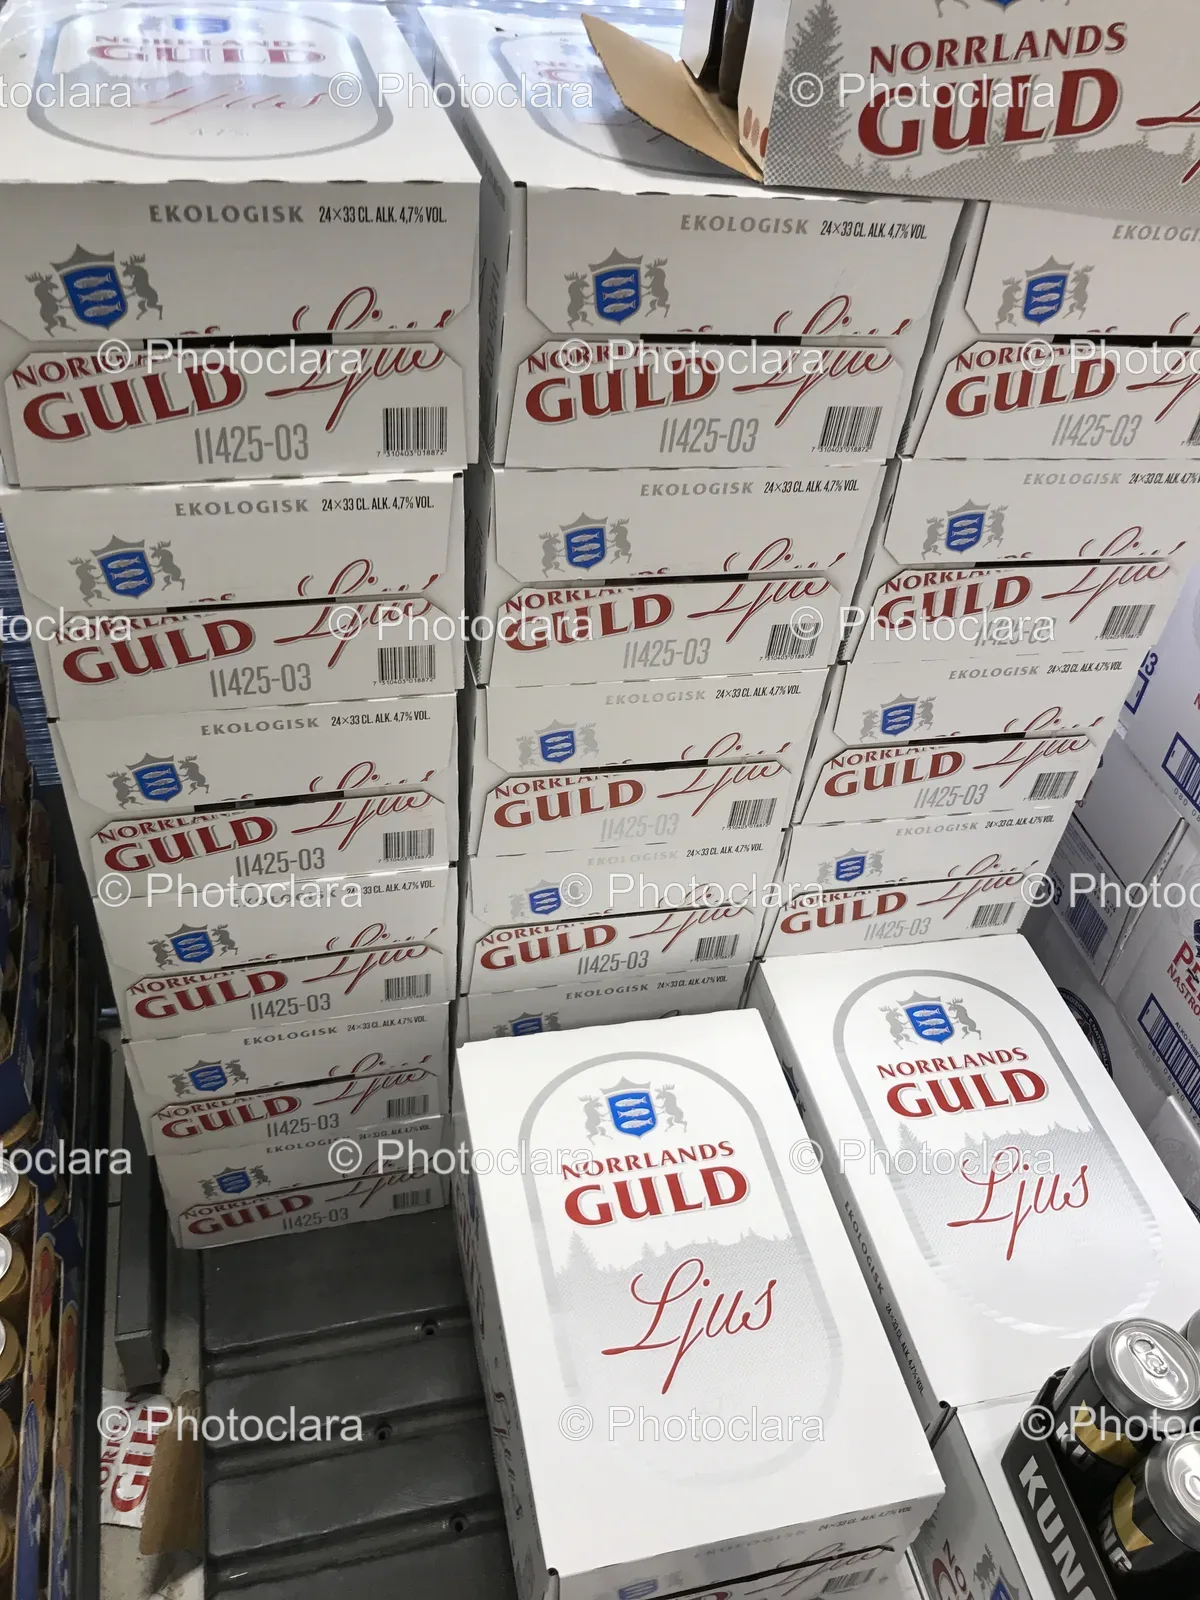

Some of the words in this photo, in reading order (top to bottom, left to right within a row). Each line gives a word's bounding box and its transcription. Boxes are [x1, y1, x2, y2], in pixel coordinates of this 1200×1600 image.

[868, 22, 1128, 76] NORRLANDS
[858, 68, 1122, 158] GULD
[149, 204, 304, 224] EKOLOGISK
[358, 206, 374, 223] CL.
[376, 206, 397, 223] ALK.
[400, 206, 424, 225] 4,7%
[425, 206, 448, 223] VOL.
[680, 214, 809, 235] EKOLOGISK
[853, 221, 866, 238] CL.
[867, 222, 886, 238] ALK.
[887, 223, 910, 239] 4,7%
[909, 224, 928, 240] VOL.
[1112, 224, 1200, 242] EKOLOGI
[23, 362, 248, 443] GULD
[525, 356, 720, 425] GULD
[945, 357, 1118, 419] GULD
[195, 424, 310, 466] 11425-03
[660, 417, 760, 454] 11425-03
[1051, 413, 1143, 447] 11425-03
[640, 480, 754, 497] EKOLOGISK
[805, 480, 823, 492] ALK.
[823, 480, 844, 492] 4,7%
[844, 479, 860, 491] VOL.
[1022, 473, 1122, 485] EKOLOGISK
[174, 499, 309, 517] EKOLOGISK
[356, 498, 370, 511] CL.
[371, 496, 391, 510] ALK.
[392, 496, 413, 510] 4,7%
[414, 496, 434, 509] VOL.
[876, 575, 1033, 631] GULD
[504, 592, 675, 653] GULD
[62, 617, 257, 686] GULD
[623, 637, 712, 669] 11425-03
[209, 663, 312, 698] 11425-03
[948, 665, 1040, 680] EKOLOGISK
[604, 690, 706, 706] EKOLOGISK
[769, 686, 787, 696] 4,7%
[786, 685, 801, 695] VOL.
[200, 717, 319, 736] EKOLOGISK
[360, 714, 374, 725] CL.
[375, 712, 393, 723] ALK.
[393, 711, 413, 722] 4,7%
[413, 710, 431, 721] VOL.
[824, 750, 965, 798] GULD
[493, 778, 645, 829] GULD
[913, 783, 989, 810] 11425-03
[104, 815, 278, 873] GULD
[600, 812, 681, 842] 11425-03
[895, 821, 980, 837] EKOLOGISK
[235, 847, 326, 879] 11425-03
[780, 891, 909, 935] GULD
[863, 916, 933, 942] 11425-03
[480, 923, 619, 971] GULD
[577, 949, 650, 976] 11425-03
[134, 969, 289, 1022] GULD
[249, 992, 332, 1021] 11425-03
[565, 983, 650, 1001] EKOLOGISK
[243, 1026, 338, 1047] EKOLOGISK
[876, 1046, 1030, 1080] NORRLANDS
[886, 1069, 1048, 1119] GULD
[161, 1095, 303, 1139] GULD
[266, 1112, 340, 1138] 11425-03
[561, 1140, 735, 1181] NORRLANDS
[188, 1194, 314, 1236] GULD
[563, 1166, 749, 1228] GULD
[946, 1145, 1090, 1262] Ljus
[283, 1206, 350, 1231] 11425-03
[844, 1200, 885, 1296] EKOLOGISK
[601, 1257, 778, 1396] Ljus
[1018, 1455, 1098, 1600] KUN
